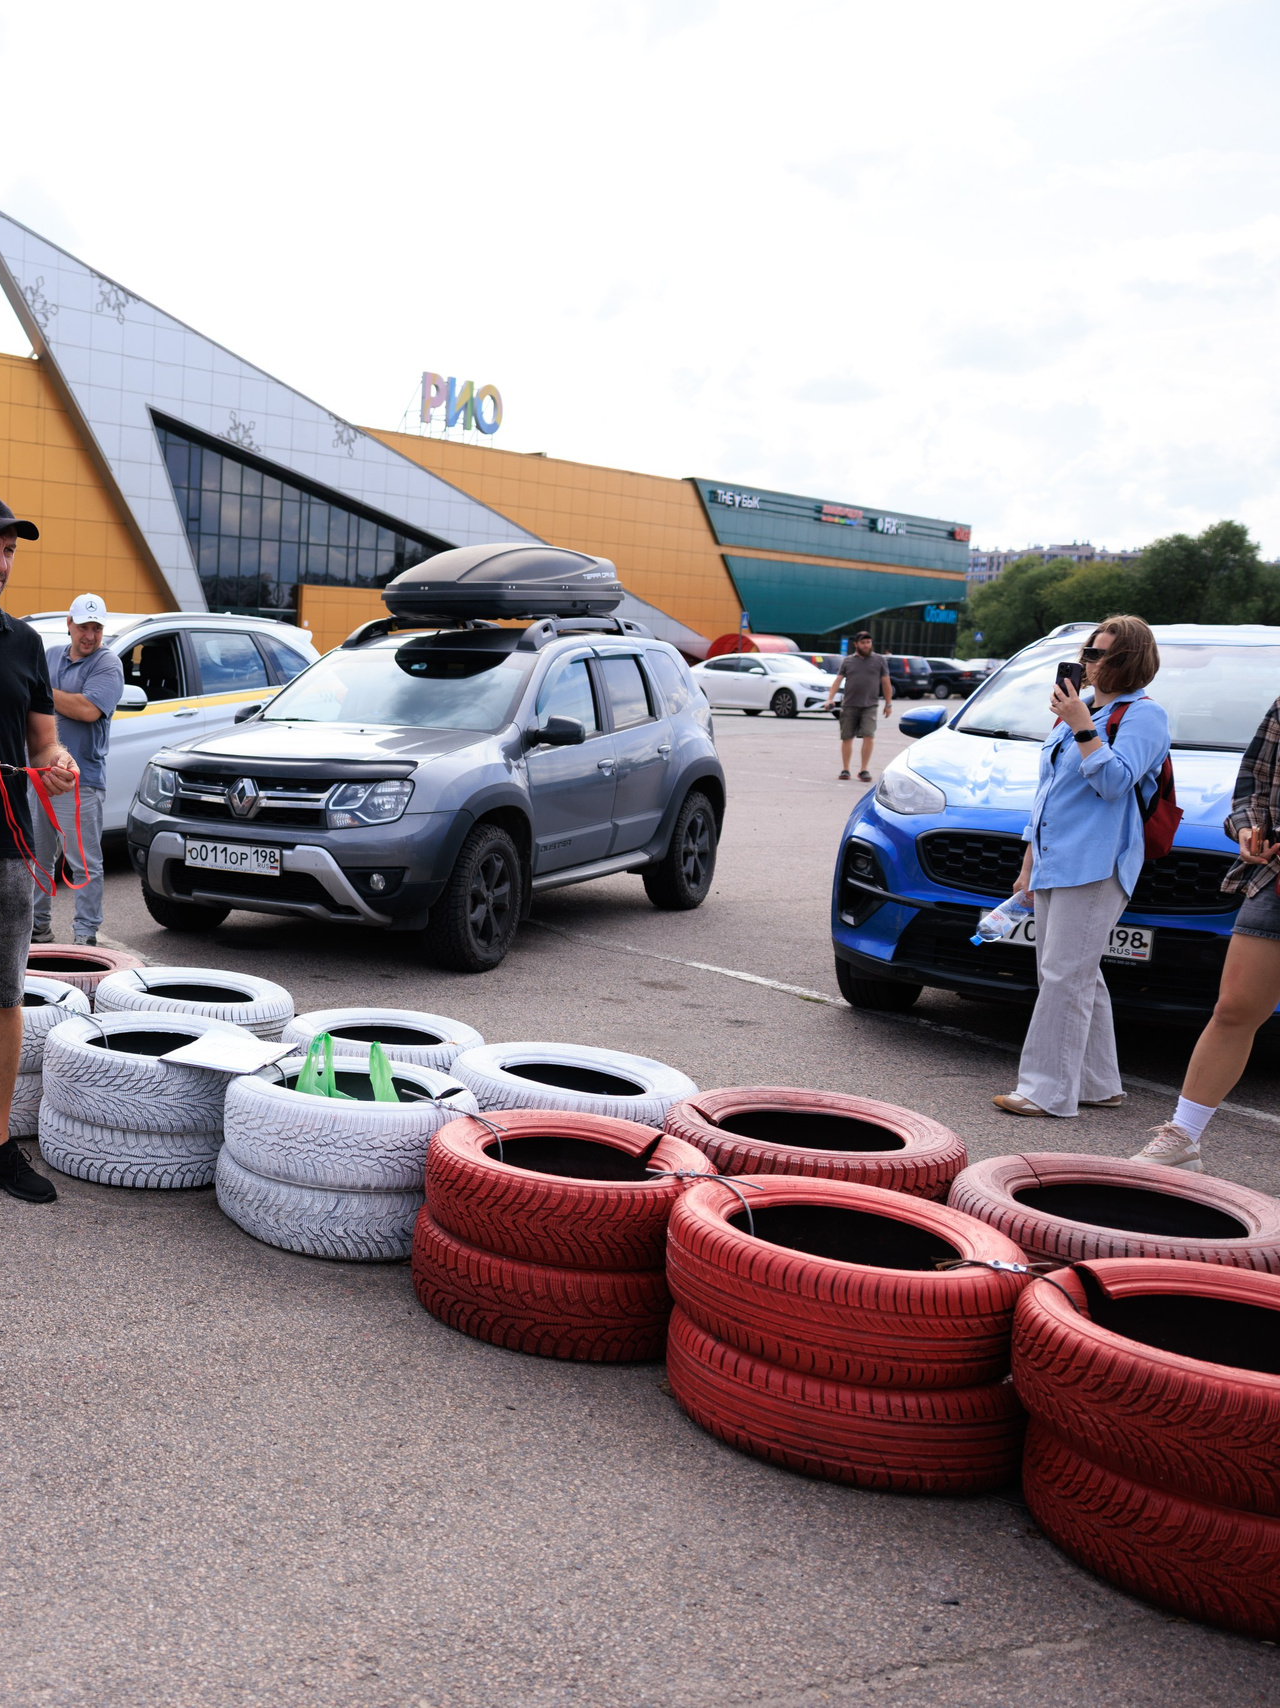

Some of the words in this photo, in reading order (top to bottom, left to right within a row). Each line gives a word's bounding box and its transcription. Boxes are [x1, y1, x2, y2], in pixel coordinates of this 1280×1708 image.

[420, 371, 503, 435] РИО
[716, 489, 734, 505] THE
[252, 848, 276, 864] 198
[1108, 928, 1144, 949] 198
[1109, 946, 1131, 956] RUS
